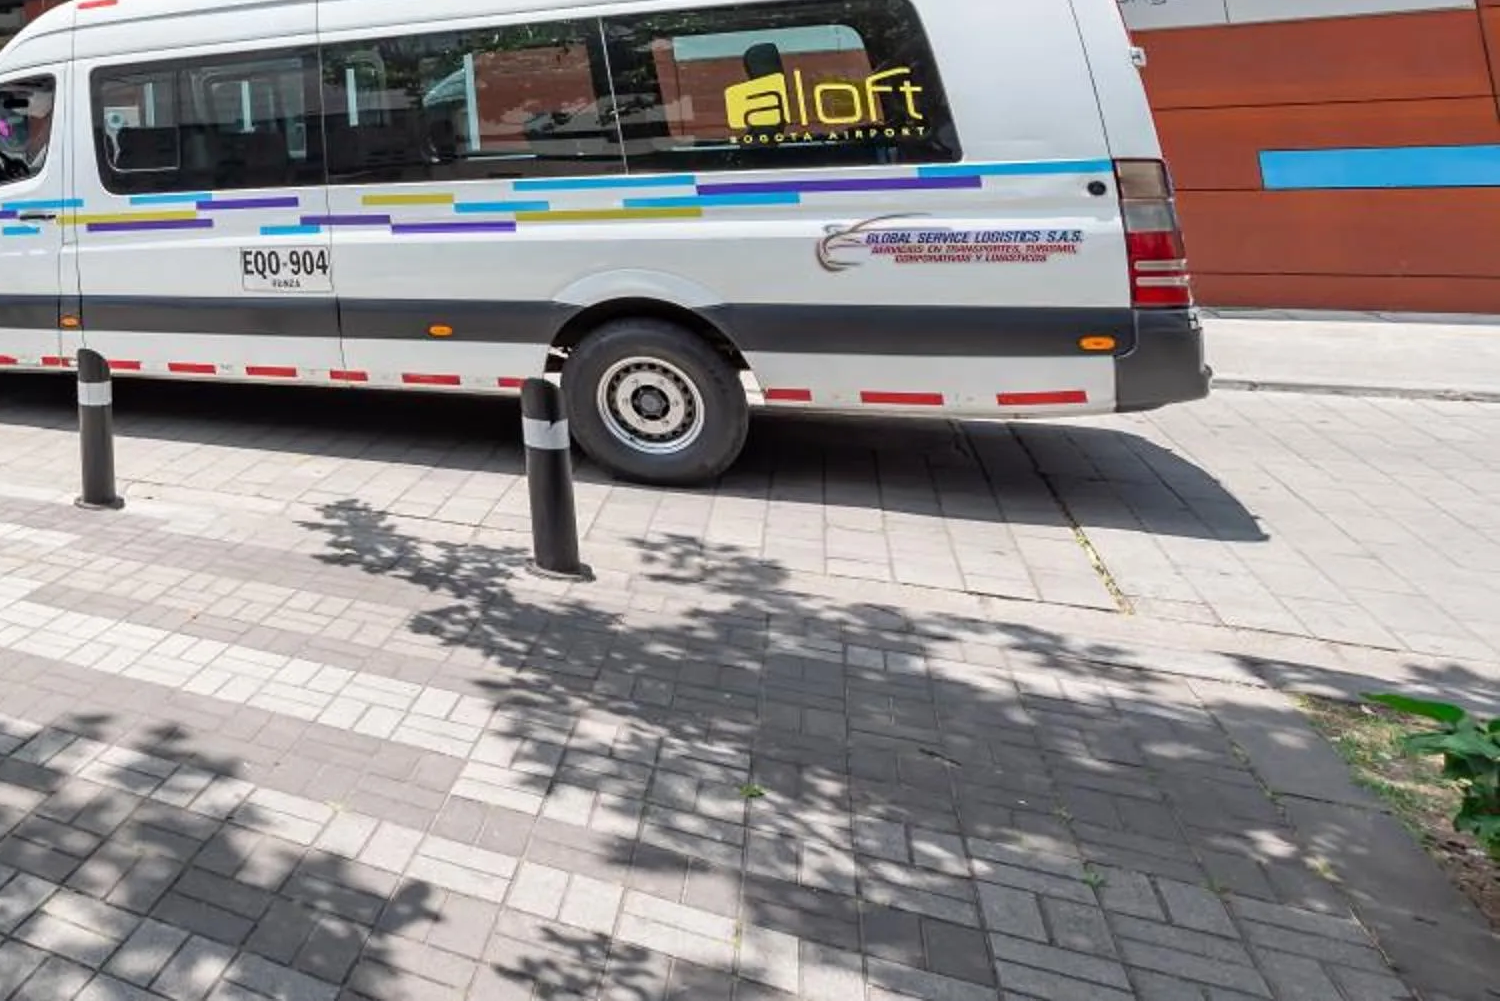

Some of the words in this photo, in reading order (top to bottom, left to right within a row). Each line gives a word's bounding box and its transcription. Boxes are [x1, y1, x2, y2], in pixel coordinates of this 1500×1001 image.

[725, 67, 923, 129] aloft
[728, 132, 813, 144] BOGOTA
[829, 126, 926, 141] AIRPORT
[865, 231, 911, 244] GLOBAL
[917, 231, 968, 244] SERVICE
[974, 230, 1041, 243] LOGISTICS
